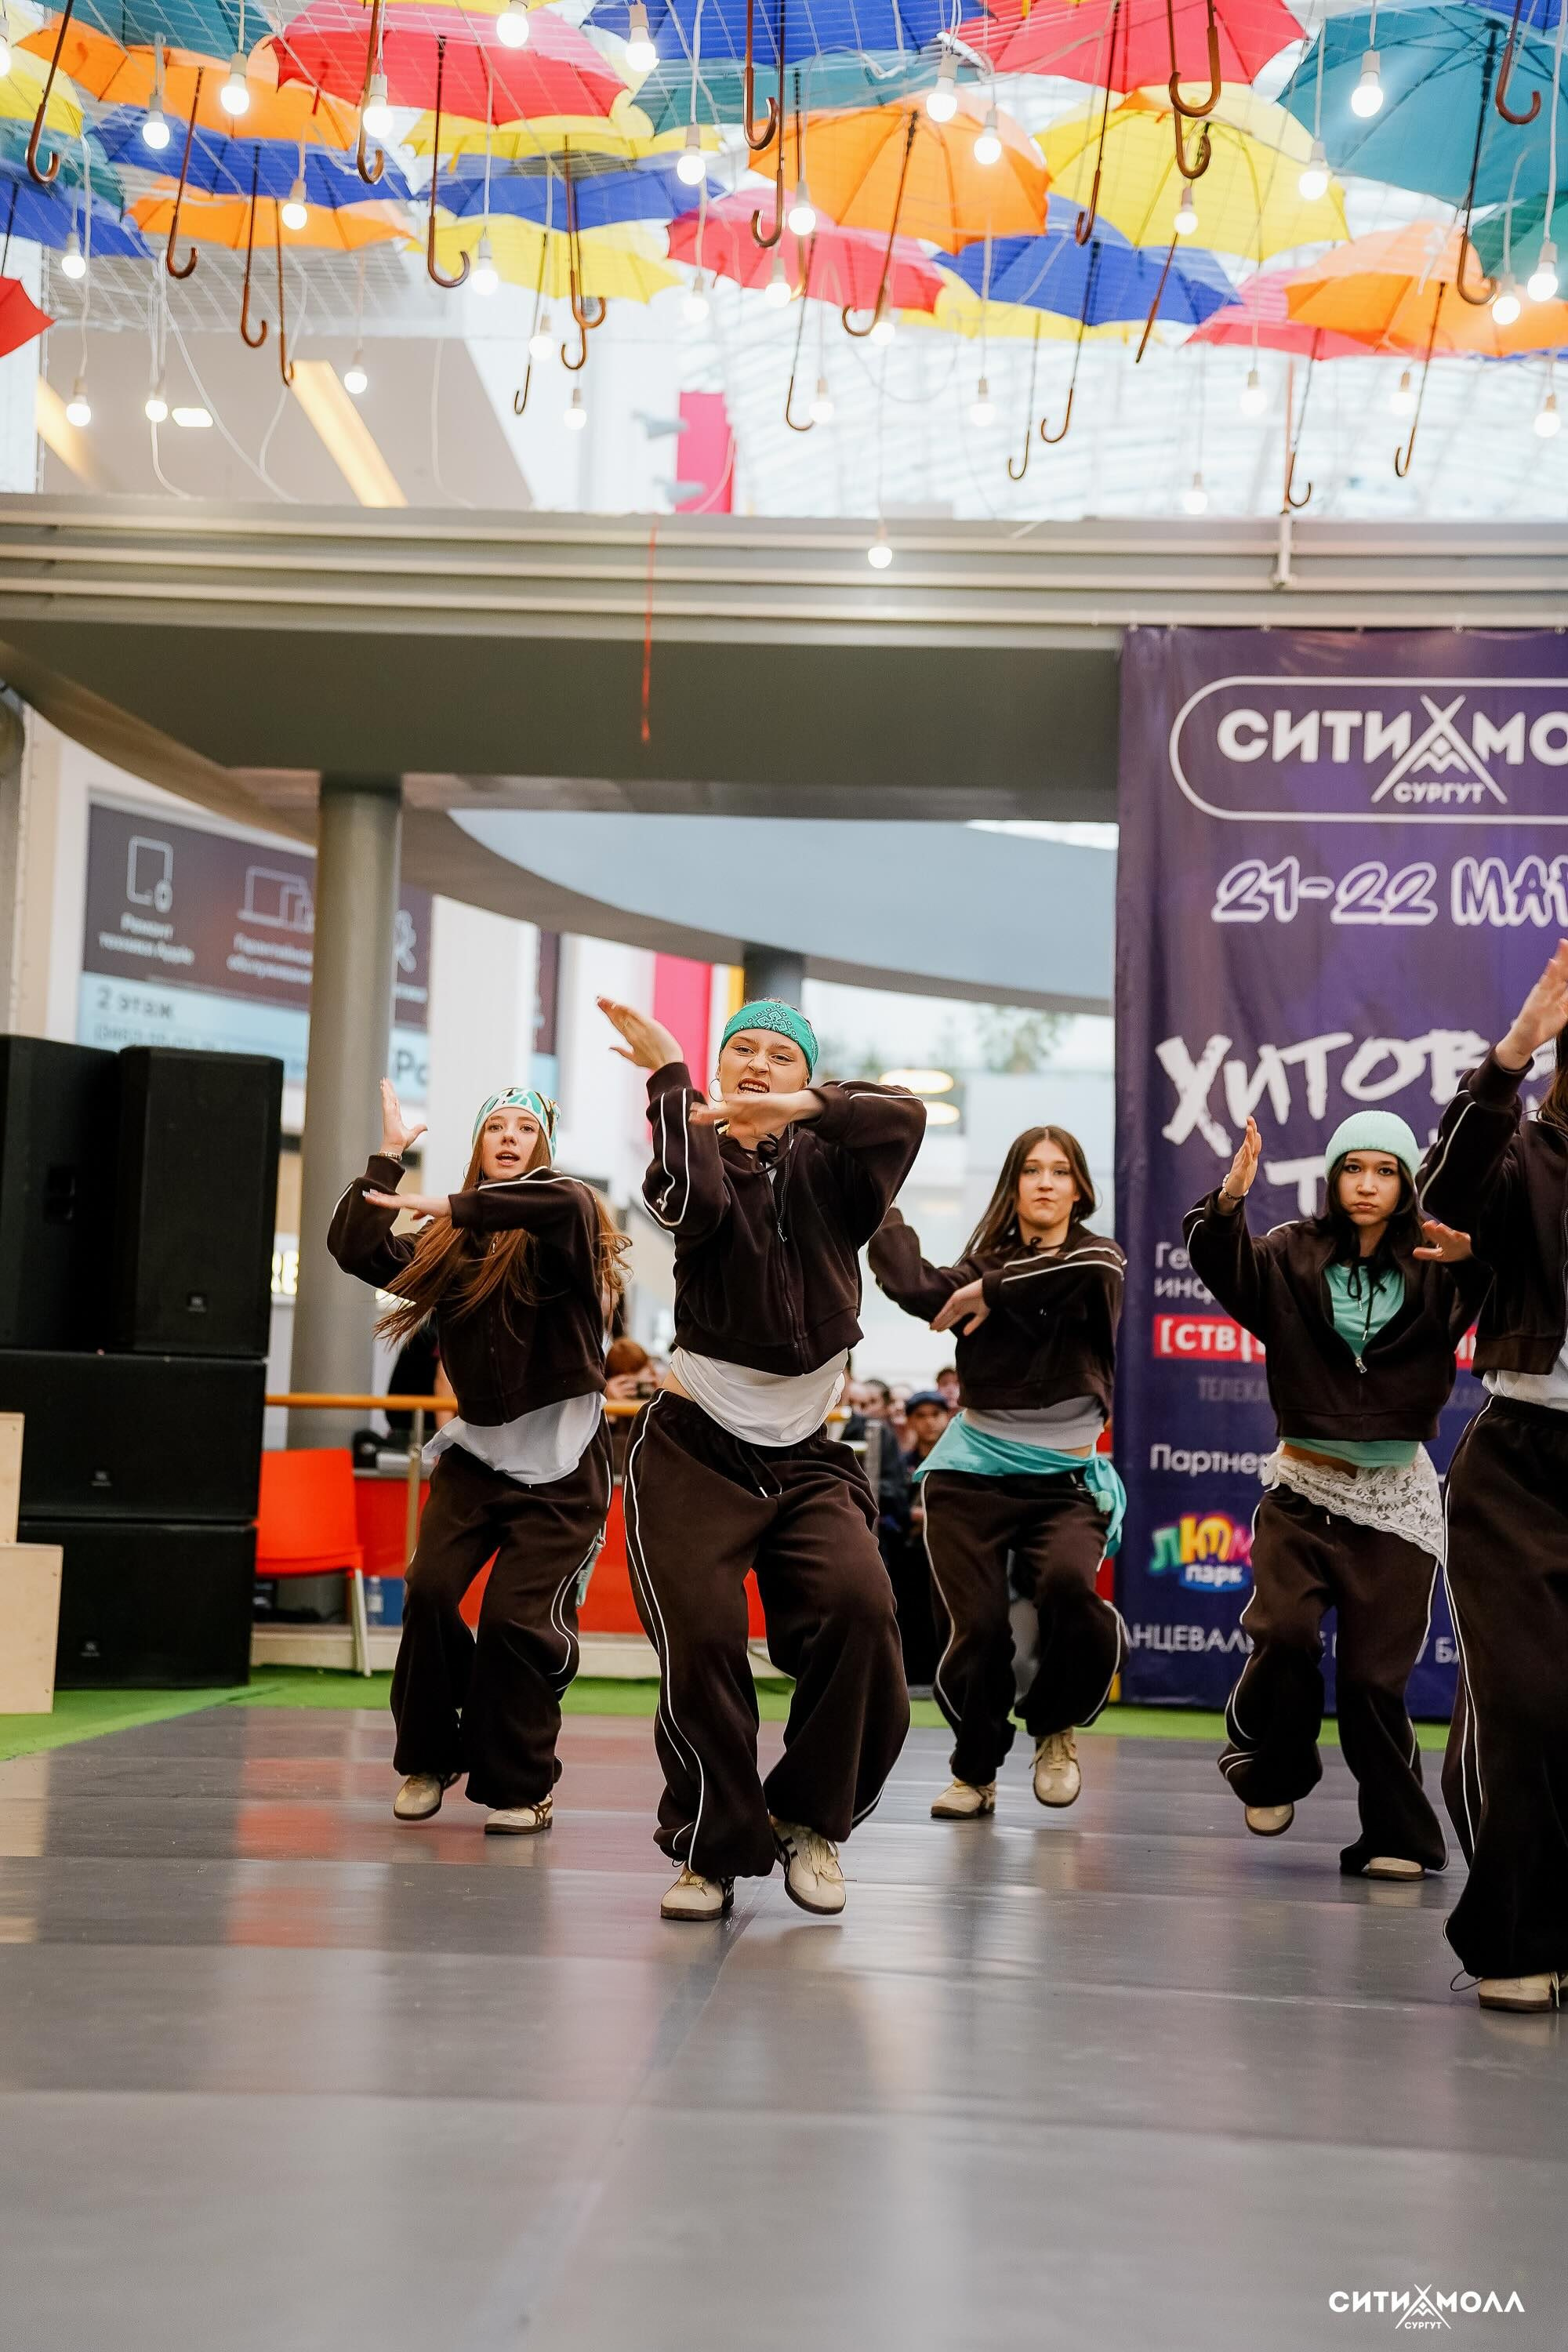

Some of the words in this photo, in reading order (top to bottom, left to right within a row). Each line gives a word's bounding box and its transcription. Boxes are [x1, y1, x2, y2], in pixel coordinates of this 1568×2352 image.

[1216, 709, 1412, 764] СИТИ
[1392, 781, 1487, 804] СУРГУТ
[1211, 856, 1439, 925] 21-22
